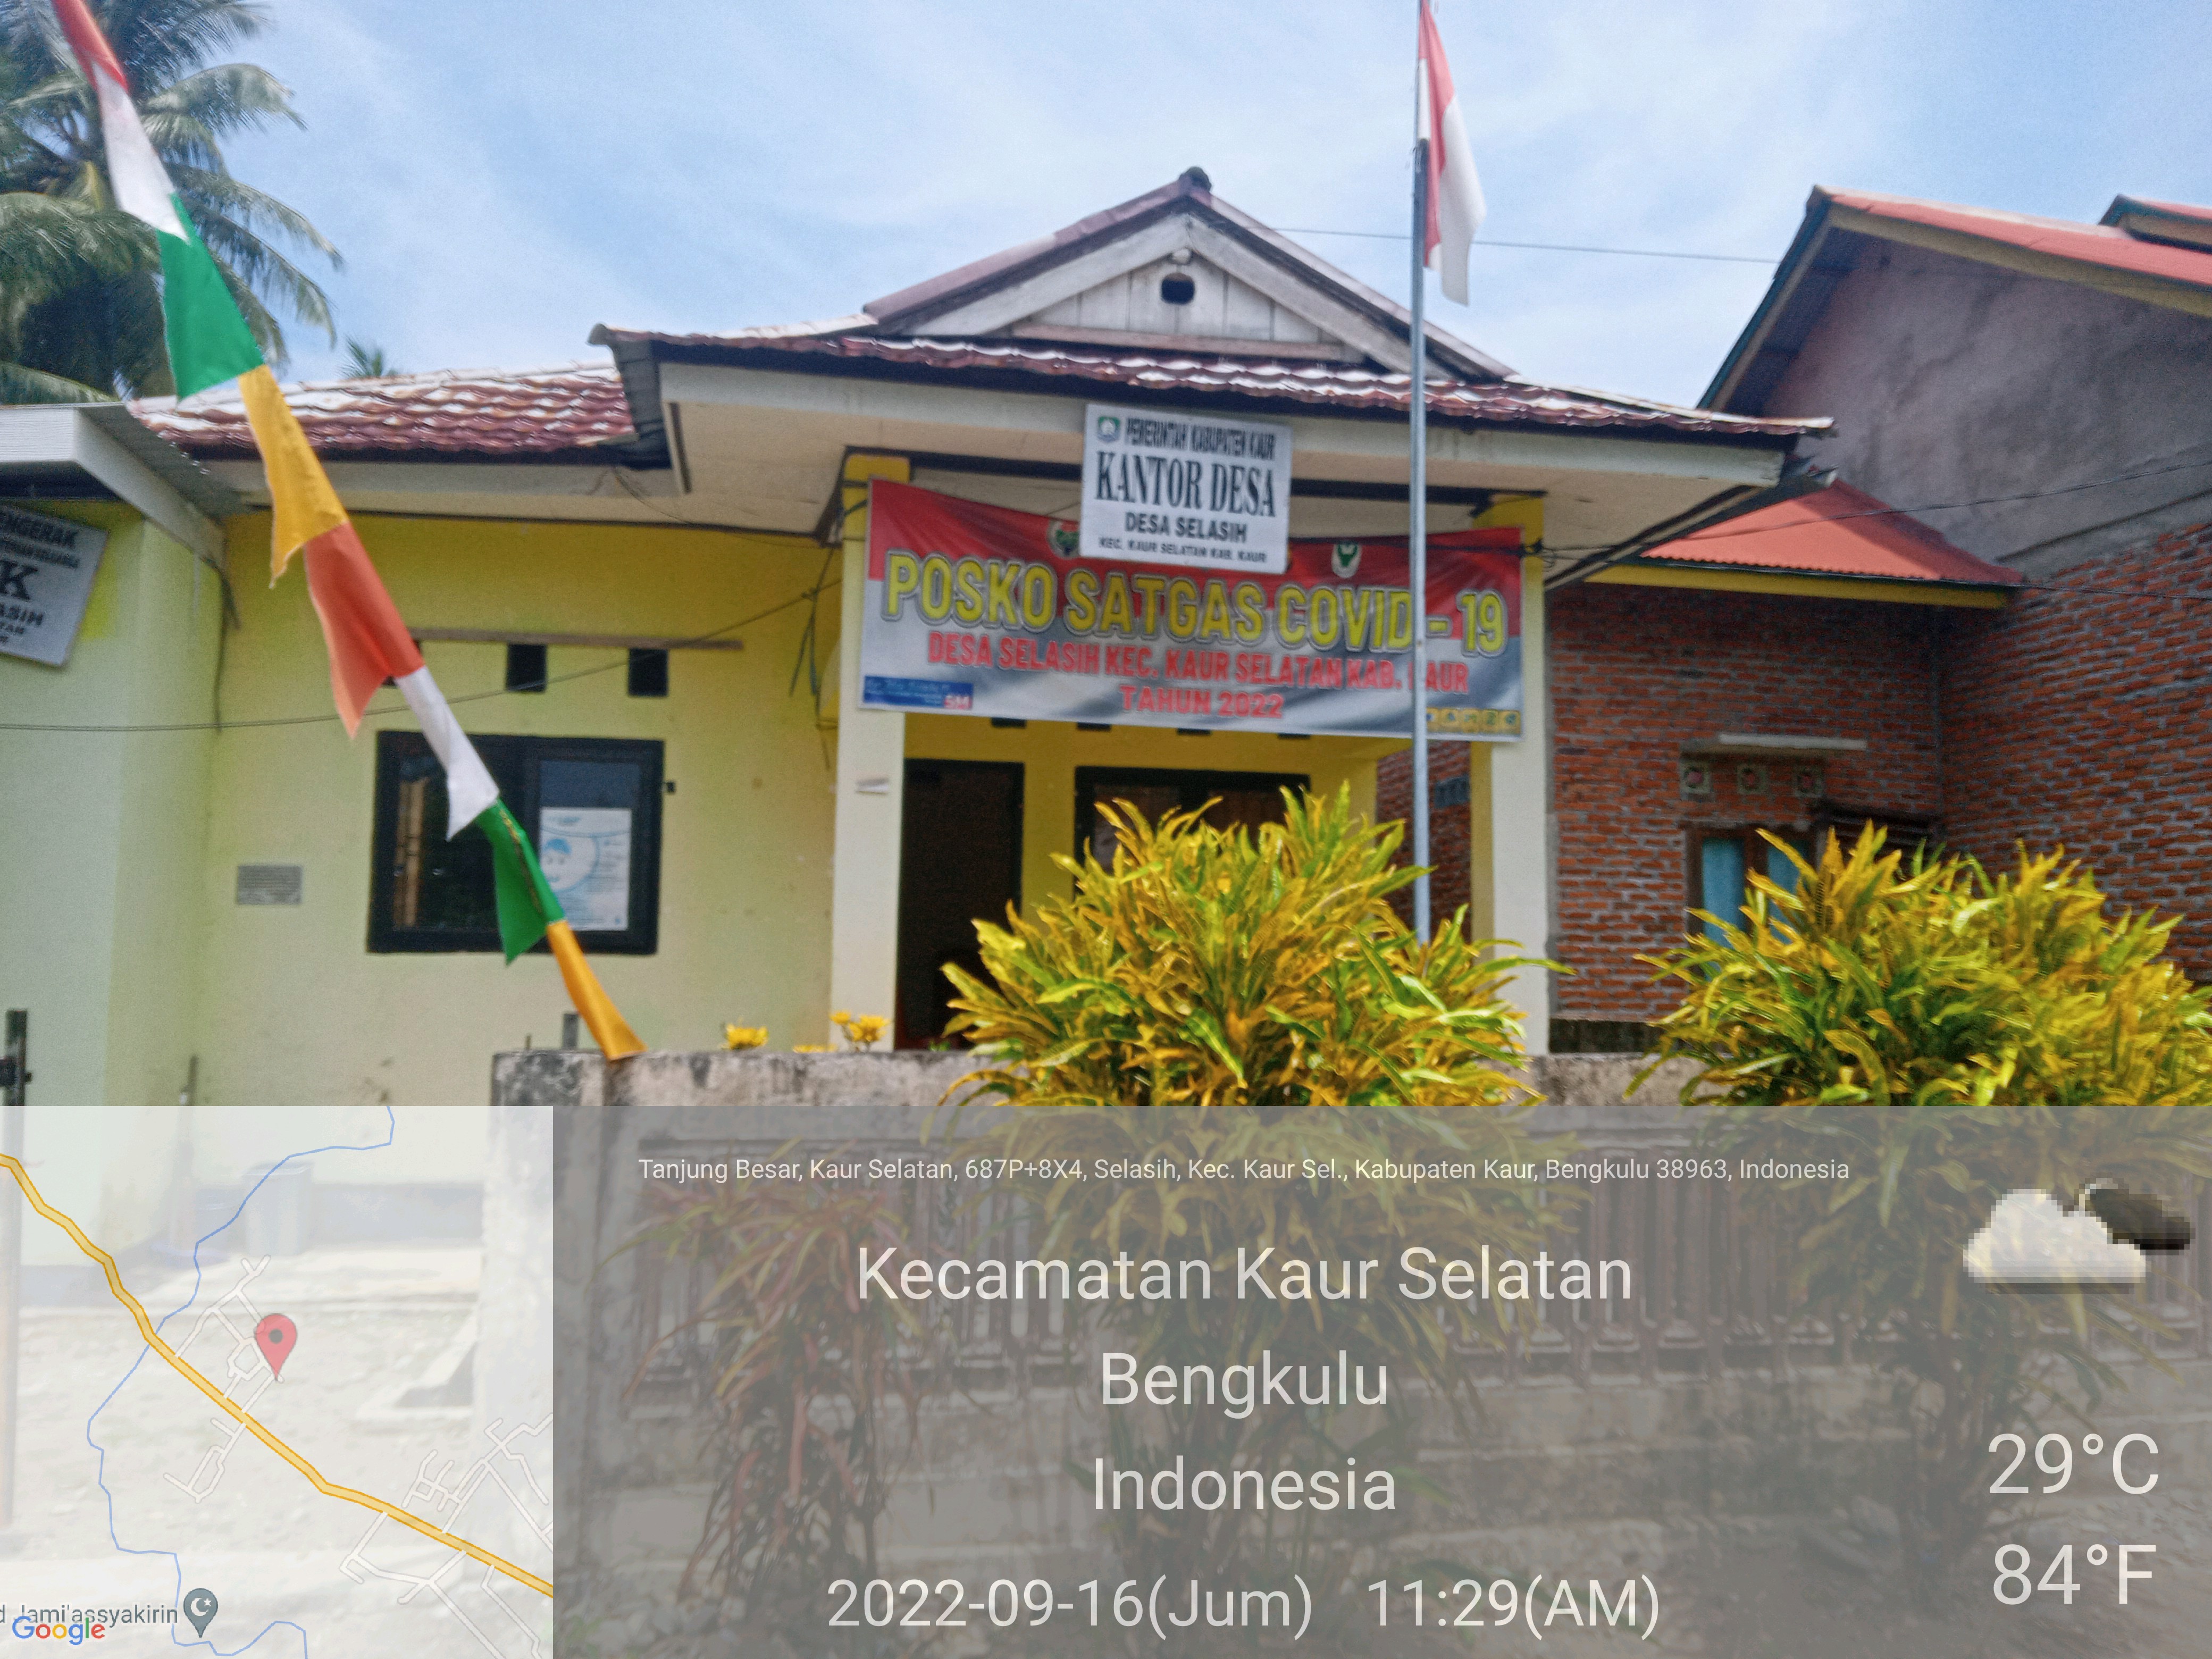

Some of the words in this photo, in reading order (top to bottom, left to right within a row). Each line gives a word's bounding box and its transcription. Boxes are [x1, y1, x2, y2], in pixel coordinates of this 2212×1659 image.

[1095, 451, 1202, 509] KANTOR
[1210, 463, 1276, 517] DESA
[1125, 512, 1170, 535] DESA
[1175, 516, 1247, 543] SELASIH
[1127, 540, 1157, 552] KAUR
[1161, 543, 1206, 557] SELATAN
[1237, 550, 1267, 563] KAUR
[881, 548, 1058, 633] POSKO
[1065, 567, 1267, 647] SATGAS
[1275, 582, 1414, 653] COVID
[1455, 589, 1508, 657] 19
[928, 631, 993, 667] DESA
[999, 636, 1100, 675] SELASIH
[1105, 646, 1158, 680] KEC.
[1166, 649, 1230, 683] KAUR
[1235, 653, 1342, 690] SELATAN
[1346, 658, 1402, 691] KAB.
[1120, 685, 1211, 716] TAHUN
[1218, 692, 1284, 719] 2022
